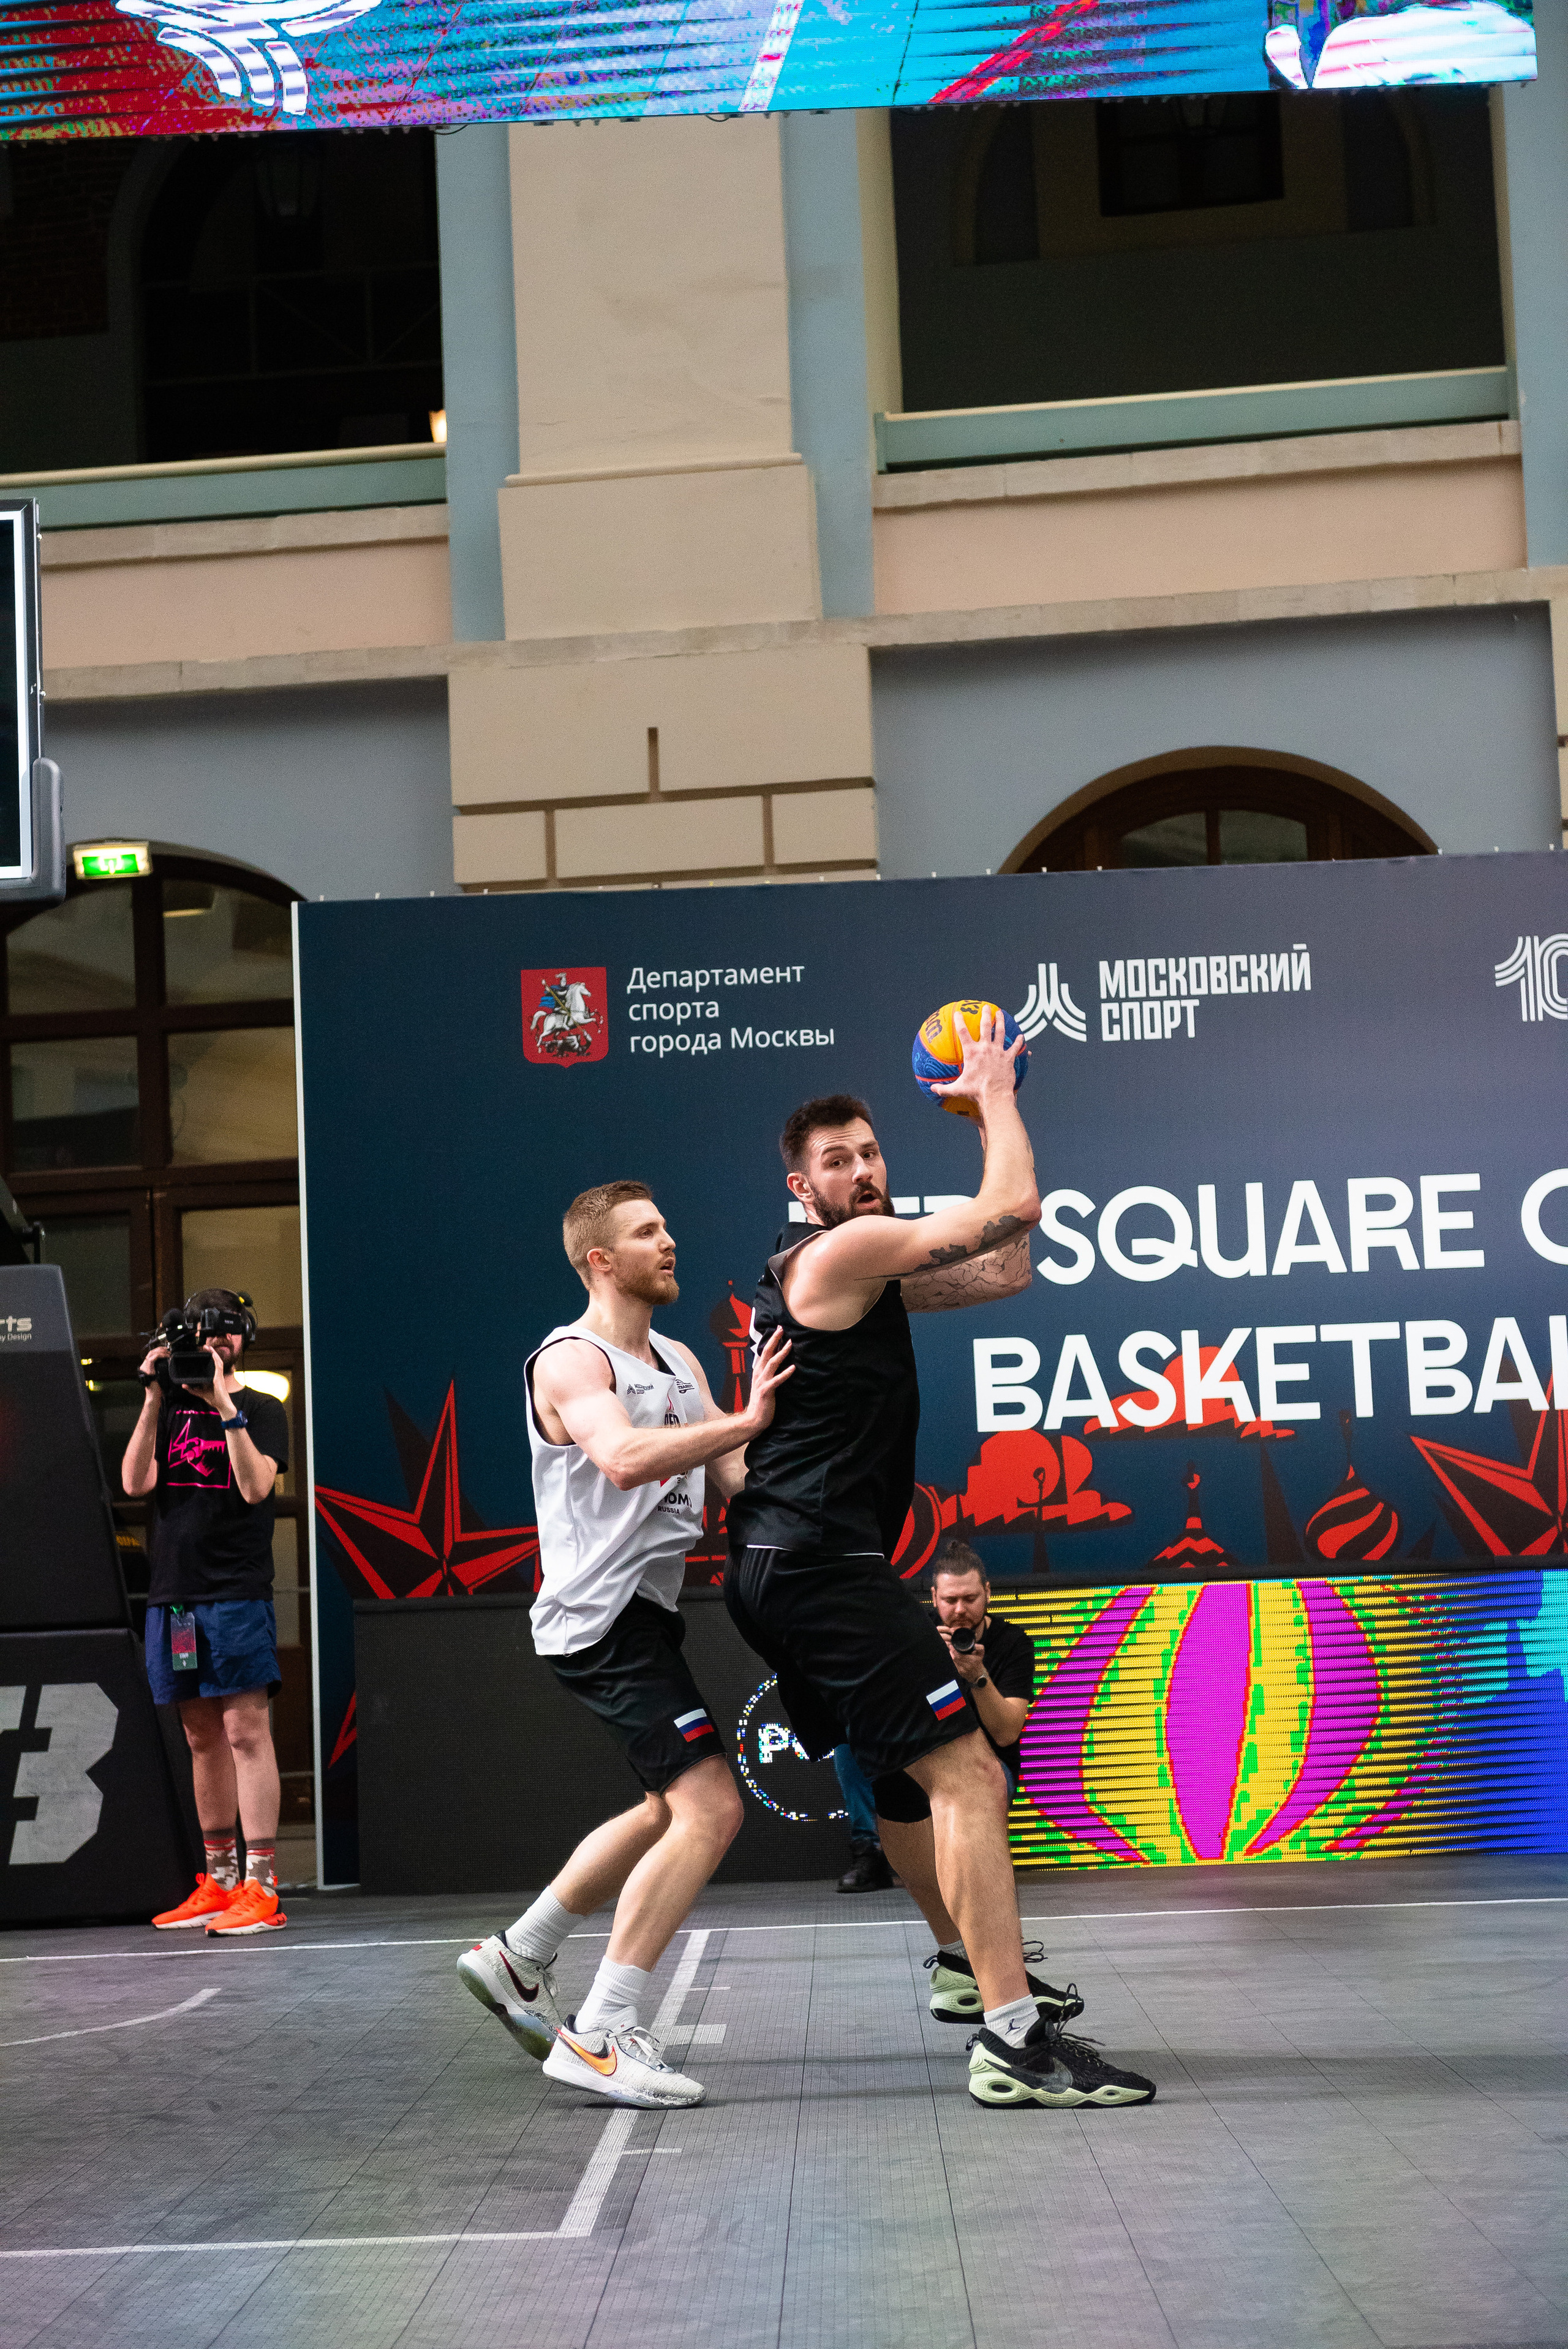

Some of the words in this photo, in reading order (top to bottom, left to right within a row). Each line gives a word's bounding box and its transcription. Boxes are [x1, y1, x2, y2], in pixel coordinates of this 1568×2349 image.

[627, 965, 805, 994] Департамент
[1099, 943, 1312, 999] МОСКОВСКИЙ
[629, 1000, 720, 1026] спорта
[1100, 998, 1200, 1042] СПОРТ
[630, 1033, 722, 1059] города
[731, 1026, 835, 1050] Москвы
[1036, 1173, 1485, 1285] SQUARE
[7, 1333, 32, 1342] Design
[657, 1505, 680, 1515] RUSSIA
